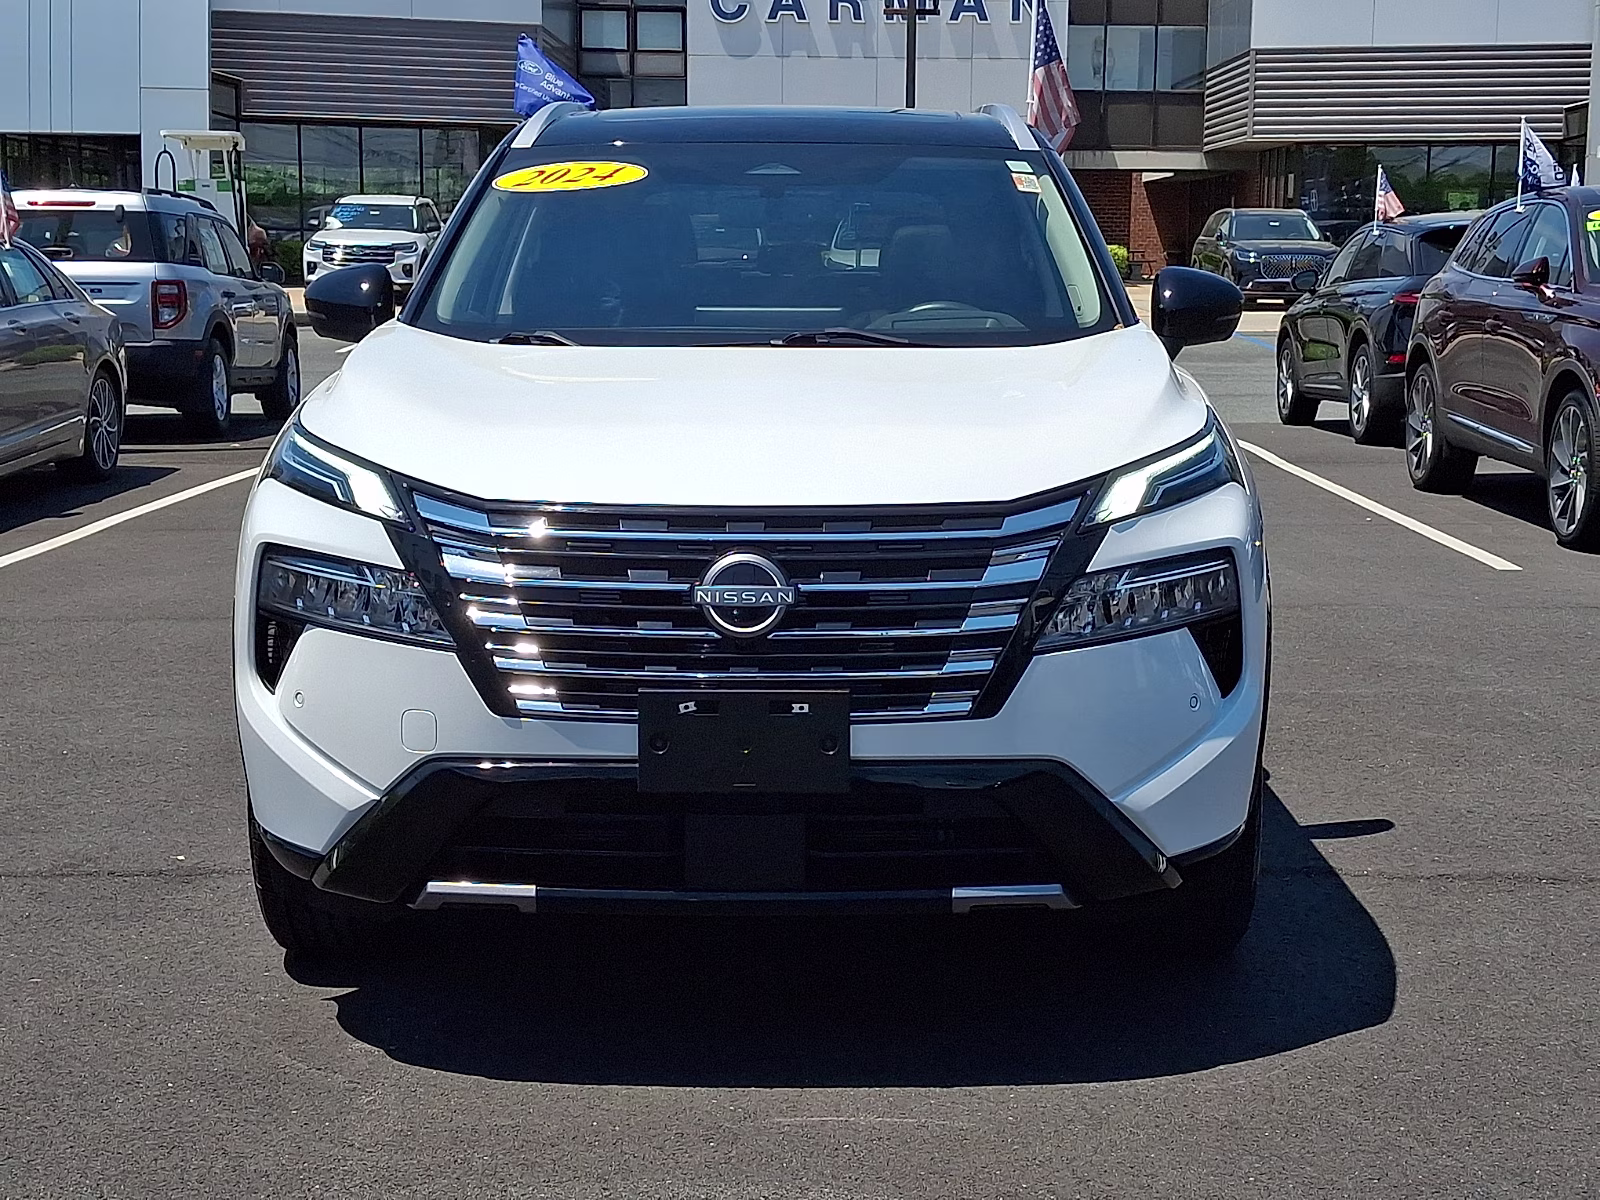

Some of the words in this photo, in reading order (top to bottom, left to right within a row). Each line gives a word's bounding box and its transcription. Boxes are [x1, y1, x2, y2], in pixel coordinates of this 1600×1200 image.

[544, 72, 564, 87] Blue
[511, 166, 628, 188] 2024
[696, 590, 793, 604] NISSAN
